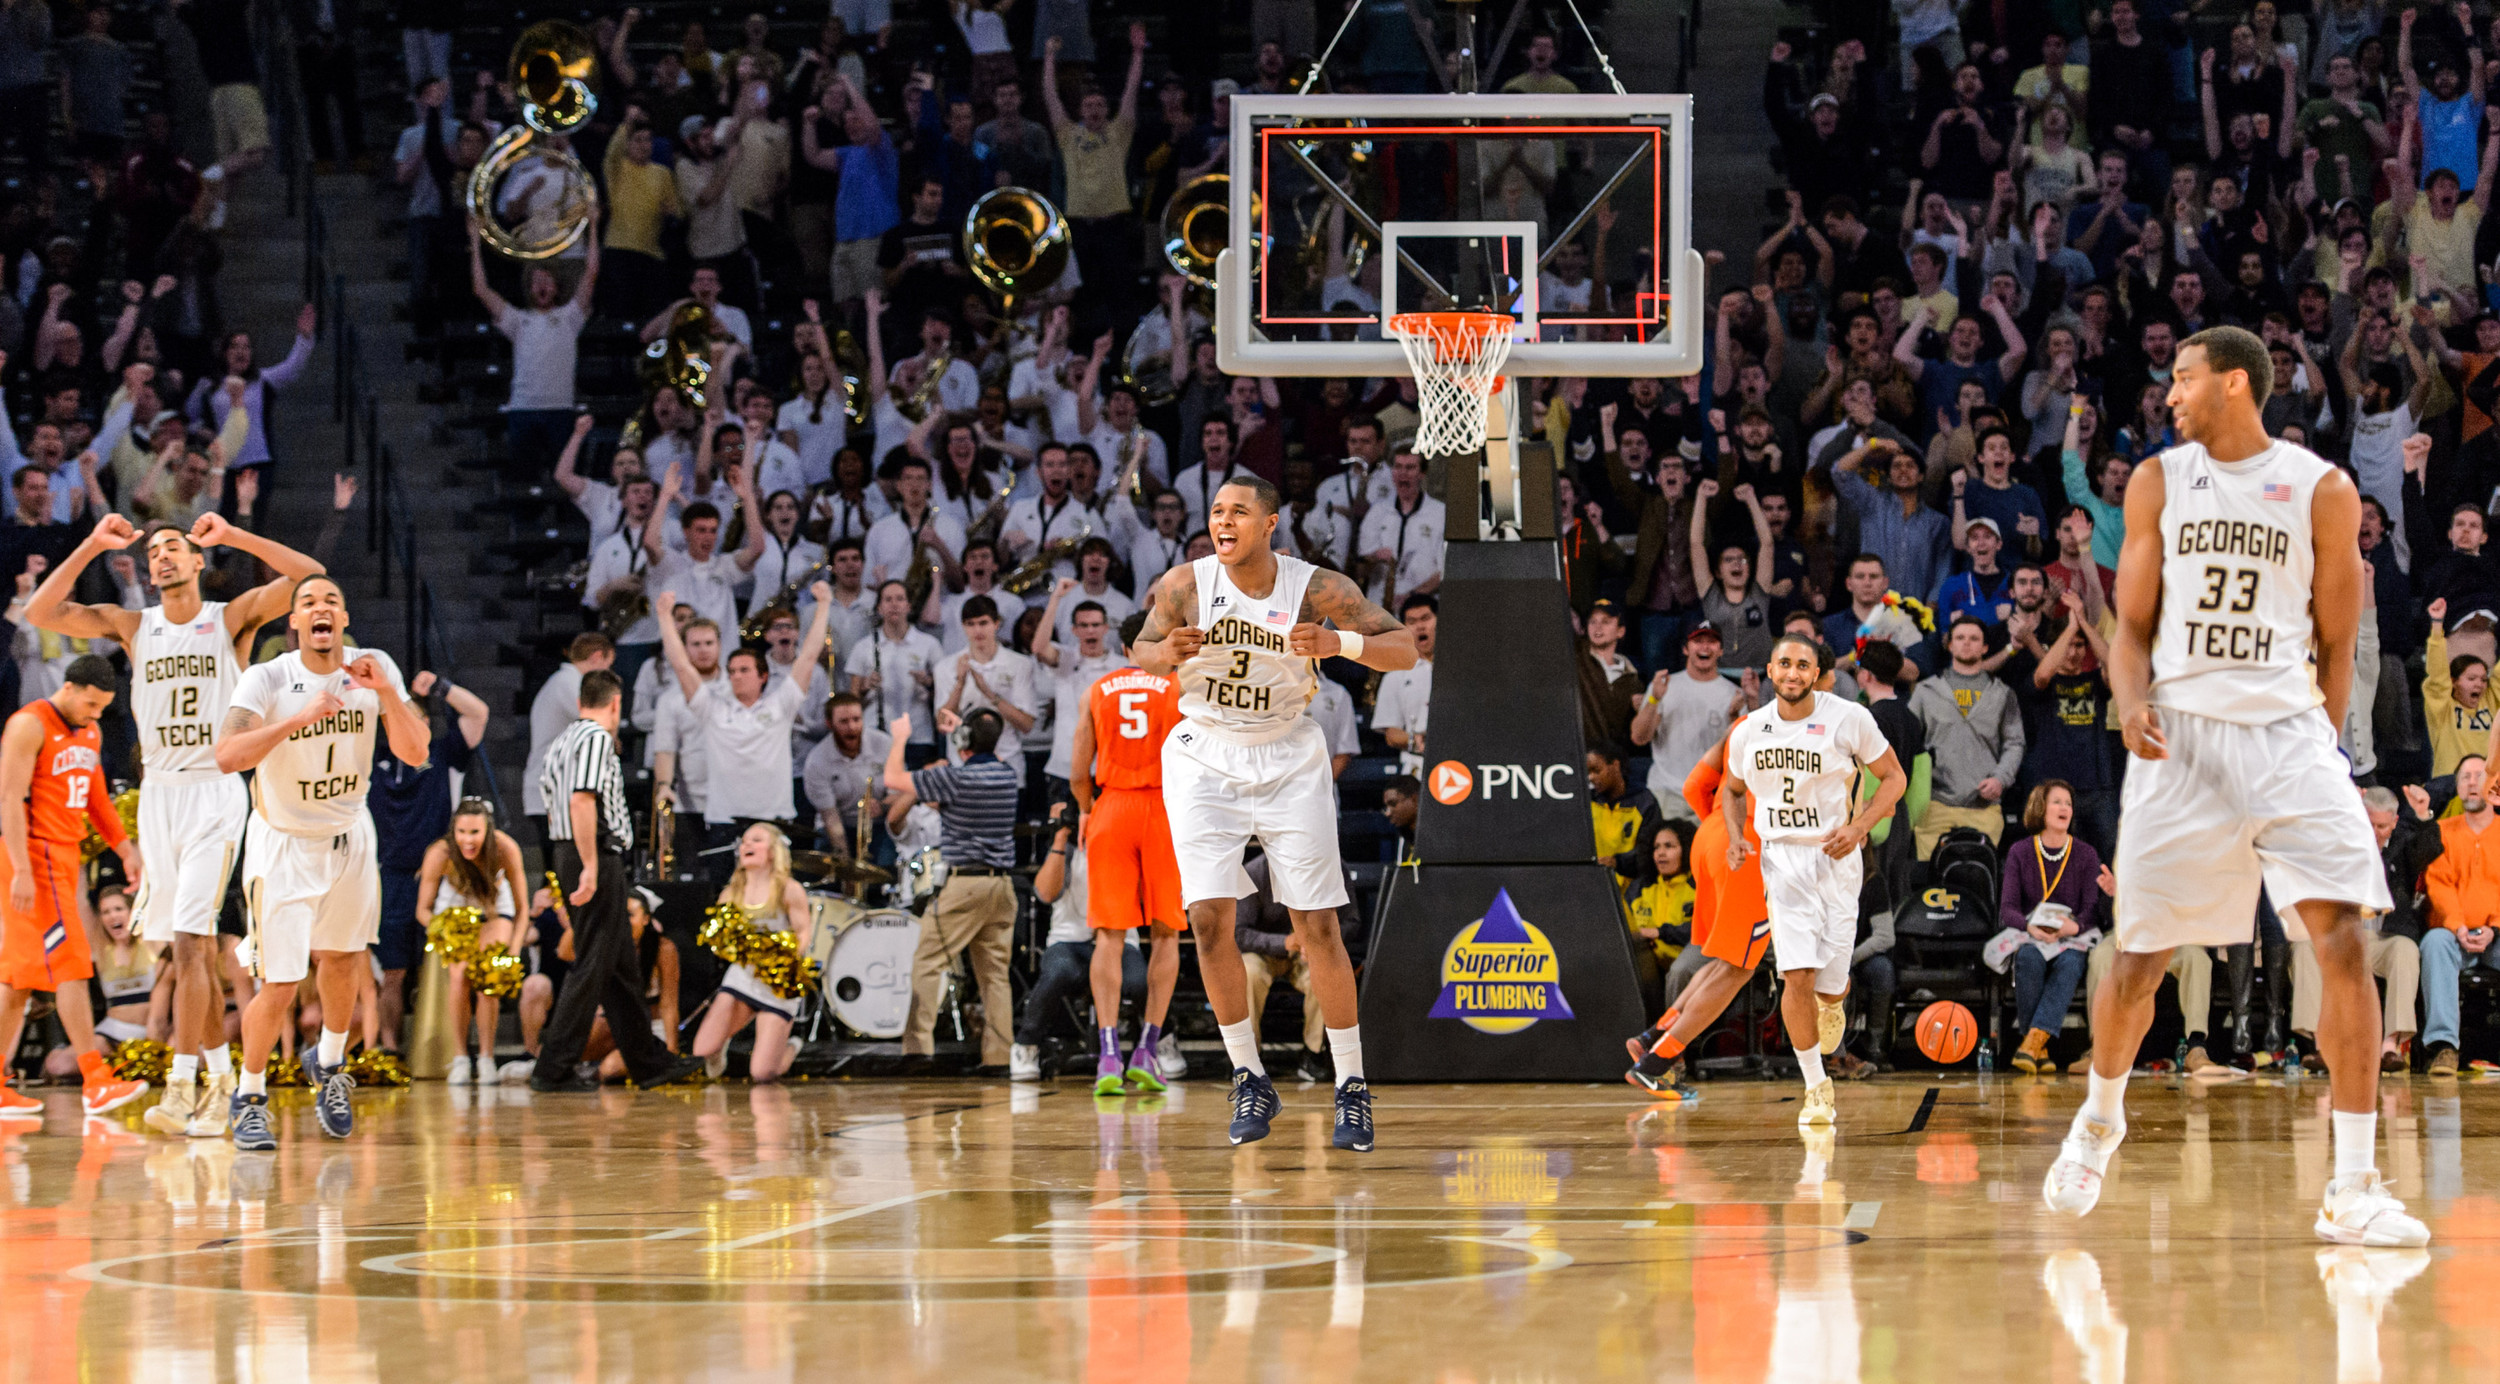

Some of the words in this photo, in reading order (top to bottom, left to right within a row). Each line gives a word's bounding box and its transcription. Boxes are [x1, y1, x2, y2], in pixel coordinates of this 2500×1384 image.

[2177, 519, 2289, 567] GEORGIA
[2197, 564, 2260, 613] 33
[2185, 621, 2273, 662] TECH
[146, 654, 217, 683] GEORGIA
[1227, 650, 1250, 681] 3
[170, 686, 198, 718] 12
[1204, 677, 1271, 711] TECH
[1119, 693, 1148, 739] 5
[156, 723, 212, 748] TECH
[326, 742, 335, 774] 1
[1755, 748, 1822, 774] GEORGIA
[65, 775, 91, 808] 12
[297, 775, 359, 801] TECH
[1477, 764, 1574, 800] PNC
[1783, 777, 1794, 805] 2
[1767, 807, 1820, 828] TECH
[1922, 888, 1960, 911] GT
[1451, 947, 1550, 979] Superior
[1455, 985, 1547, 1011] PLUMBING
